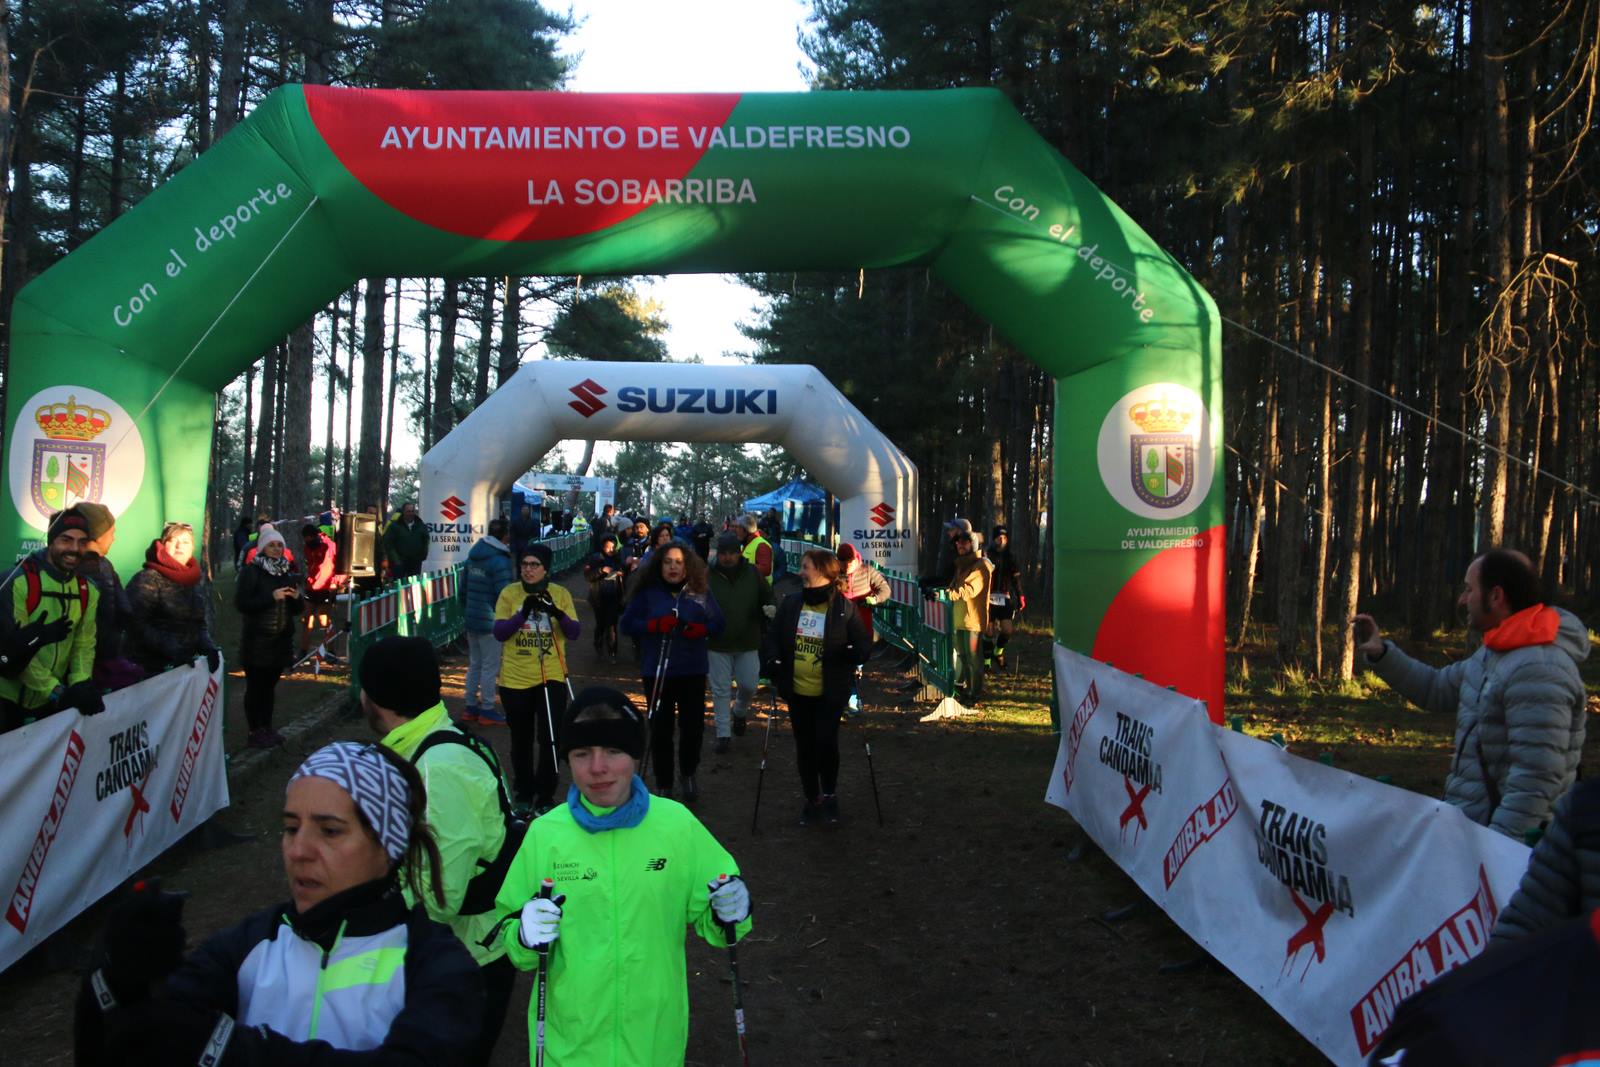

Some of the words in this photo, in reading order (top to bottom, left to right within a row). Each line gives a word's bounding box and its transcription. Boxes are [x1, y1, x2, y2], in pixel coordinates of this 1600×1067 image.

[380, 126, 627, 149] AYUNTAMIENTO
[637, 126, 680, 149] DE
[688, 125, 911, 149] VALDEFRESNO
[527, 179, 565, 206] LA
[574, 178, 757, 206] SOBARRIBA
[113, 282, 158, 327] Con
[165, 248, 188, 278] el
[194, 183, 292, 252] deporte
[994, 185, 1041, 221] Con
[1048, 223, 1076, 243] el
[1077, 243, 1154, 323] deporte
[616, 386, 778, 415] SUZUKI
[424, 522, 484, 534] SUZUKI
[440, 535, 461, 543] SERNA
[853, 528, 911, 540] SUZUKI
[1126, 526, 1199, 537] AYUNTAMIENTO
[861, 541, 870, 549] LA
[870, 541, 892, 549] SERNA
[1121, 539, 1136, 550] DE
[1137, 538, 1204, 550] VALDEFRESNO
[109, 720, 151, 765] TRANS
[1116, 711, 1154, 758] TRANS
[1099, 735, 1163, 796] CANDAMIA
[1260, 799, 1329, 867] TRANS
